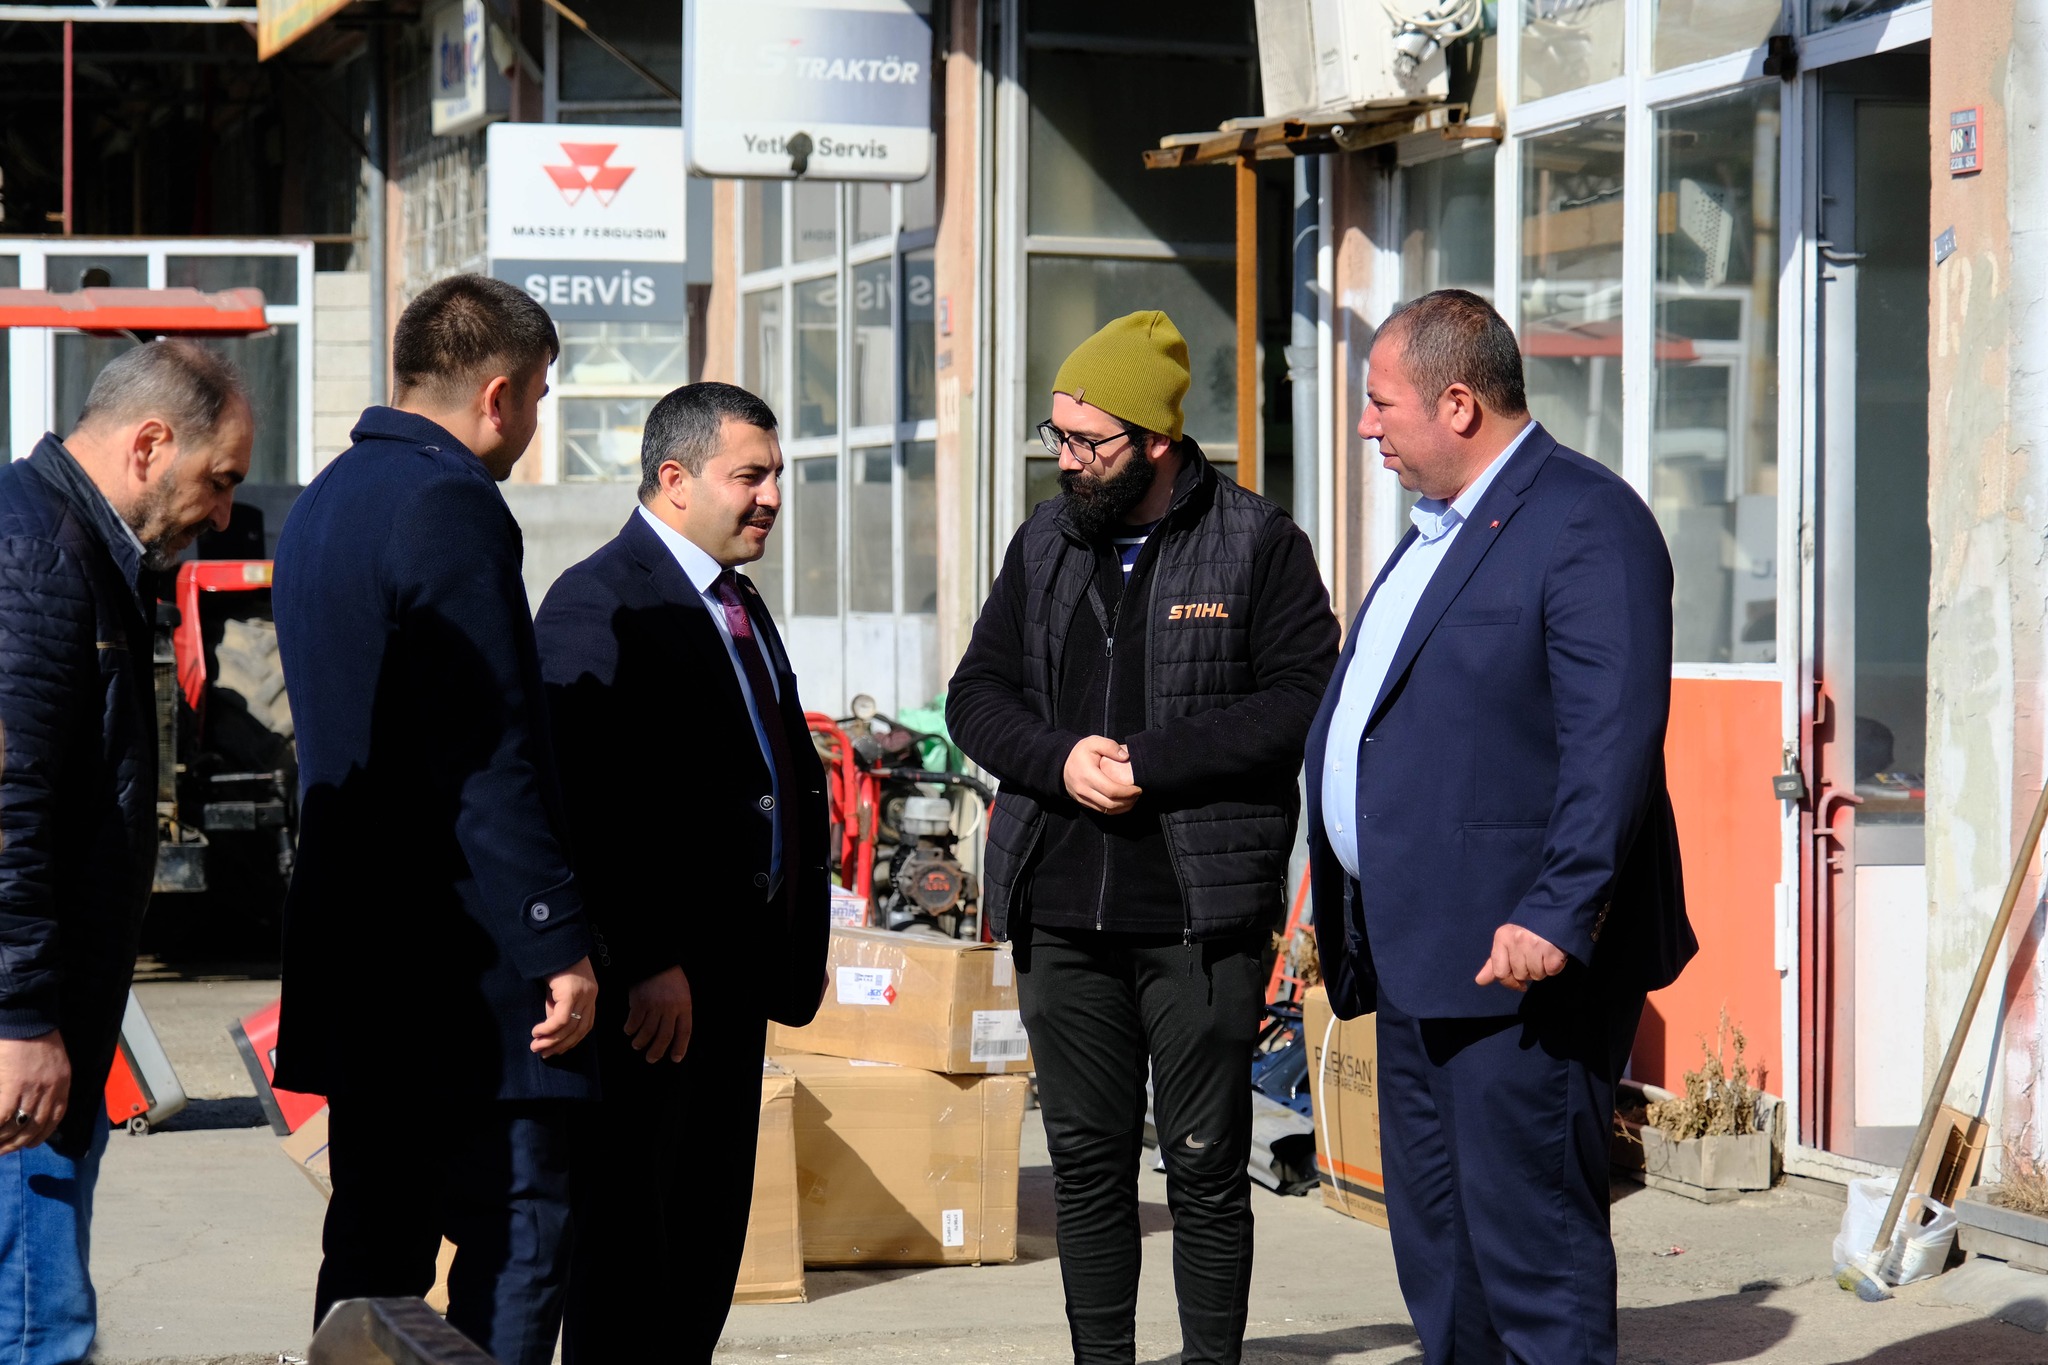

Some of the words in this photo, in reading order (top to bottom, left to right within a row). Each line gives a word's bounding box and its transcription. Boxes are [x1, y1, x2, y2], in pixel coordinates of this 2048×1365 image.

[796, 54, 920, 84] TRAKTÖR
[744, 133, 802, 154] Yetk
[818, 136, 888, 159] Servis
[512, 226, 576, 236] MASSEY
[583, 227, 667, 239] FERGUSON
[1168, 602, 1229, 620] STIHL
[1315, 1046, 1372, 1083] PLEKSAN
